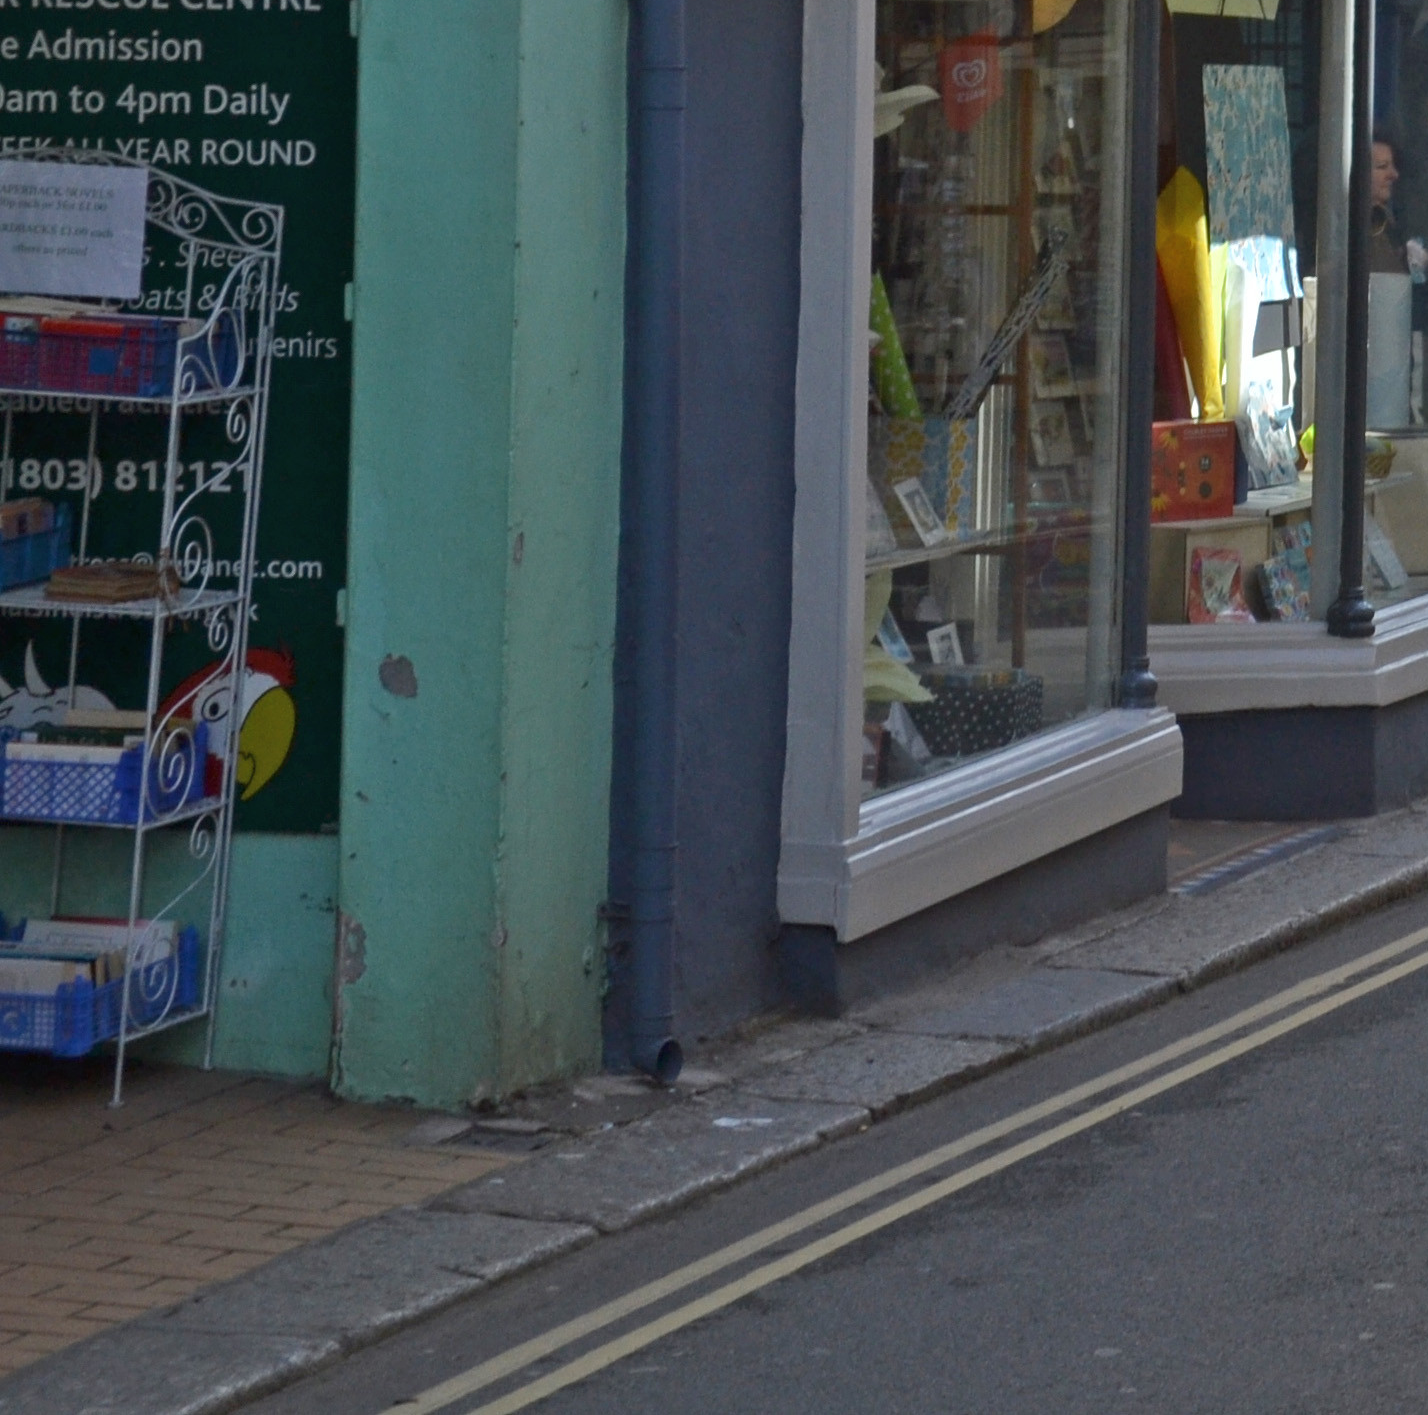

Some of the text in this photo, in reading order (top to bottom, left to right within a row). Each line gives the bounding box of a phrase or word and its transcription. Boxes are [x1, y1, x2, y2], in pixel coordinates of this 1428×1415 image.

[28, 28, 204, 62] Admission
[68, 85, 106, 114] to
[116, 83, 192, 123] 4pm
[204, 82, 291, 125] Daily
[116, 138, 192, 166] YEAR
[202, 139, 317, 168] ROUND
